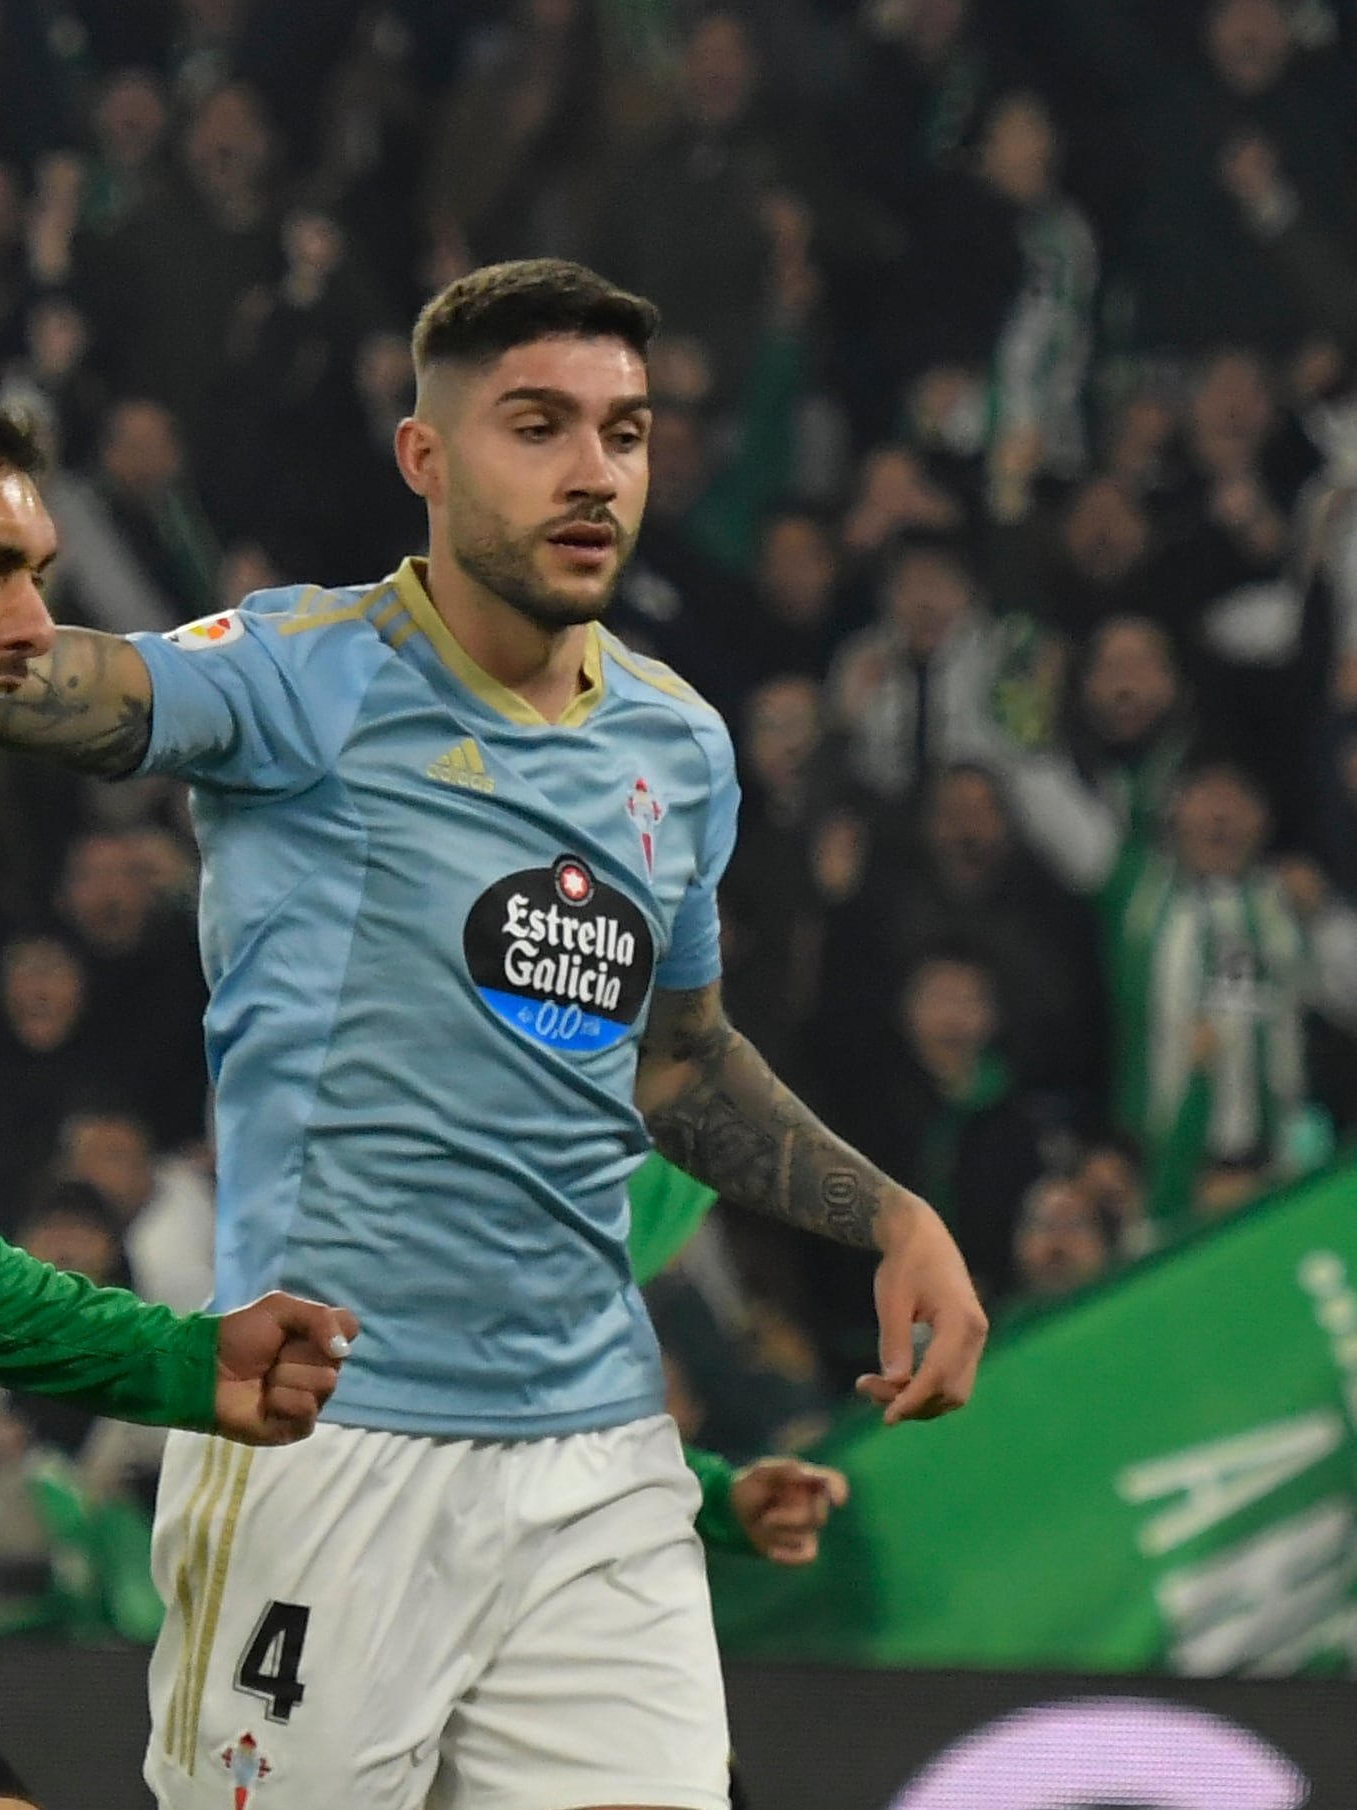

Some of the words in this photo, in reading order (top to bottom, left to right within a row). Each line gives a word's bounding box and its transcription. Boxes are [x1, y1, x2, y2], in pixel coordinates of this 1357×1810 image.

[502, 893, 635, 967] Estrella
[504, 939, 621, 1011] Galicia
[232, 1599, 311, 1726] 4
